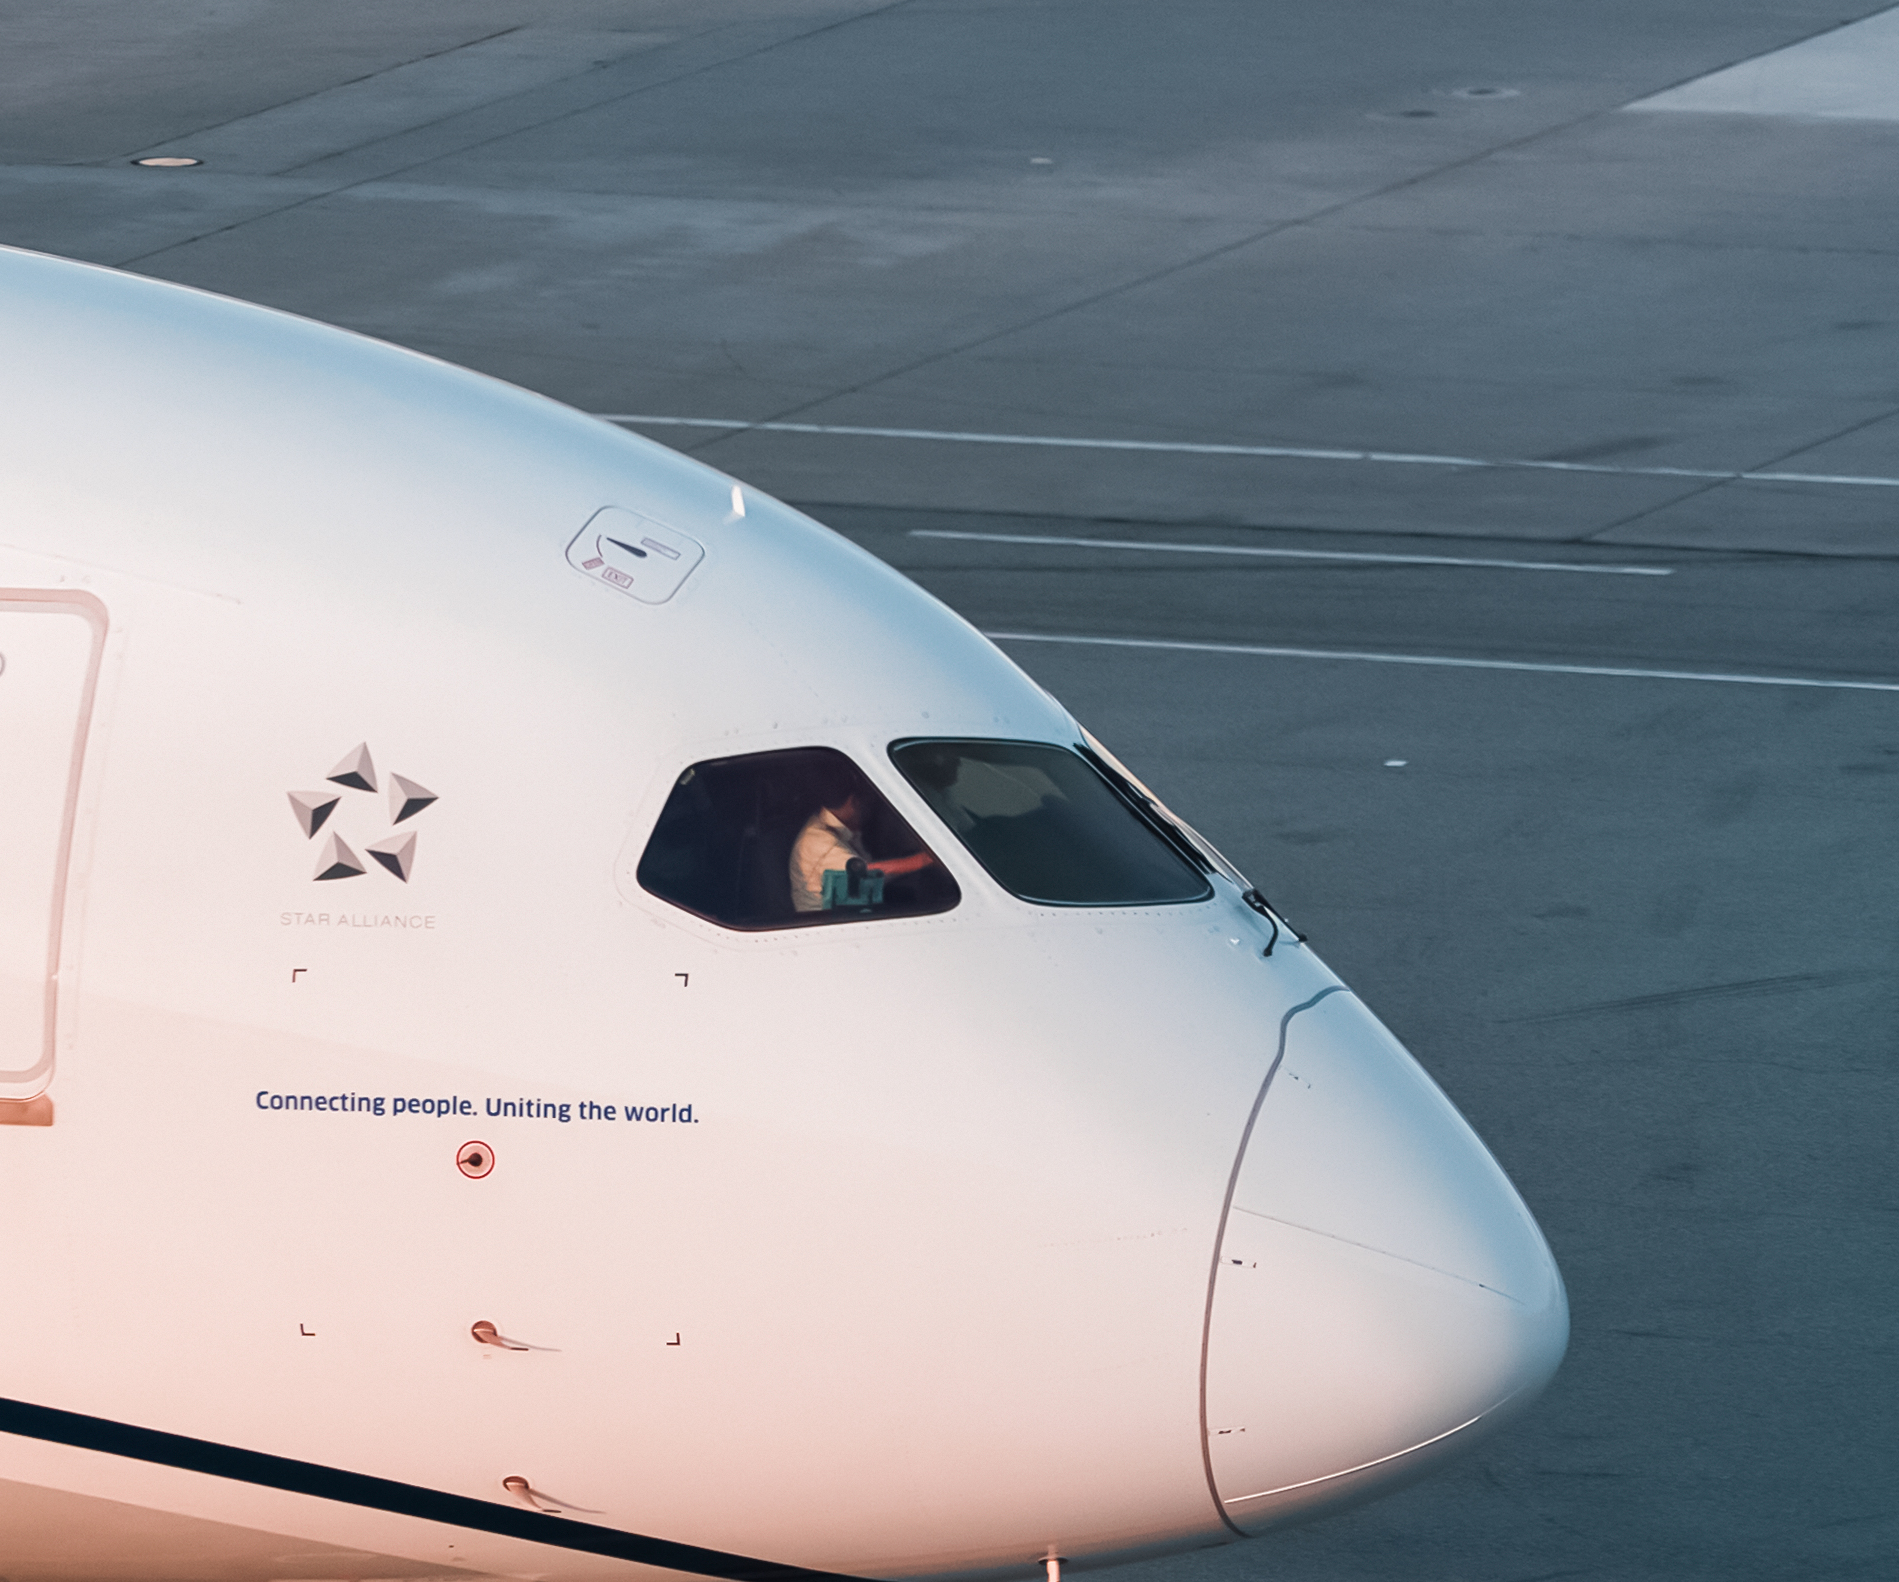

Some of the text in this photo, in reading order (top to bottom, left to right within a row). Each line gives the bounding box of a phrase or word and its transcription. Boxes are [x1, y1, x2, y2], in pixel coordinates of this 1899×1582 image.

[280, 912, 436, 929] STAR ALLIANCE
[256, 1090, 699, 1124] Connecting people. Uniting the world.
